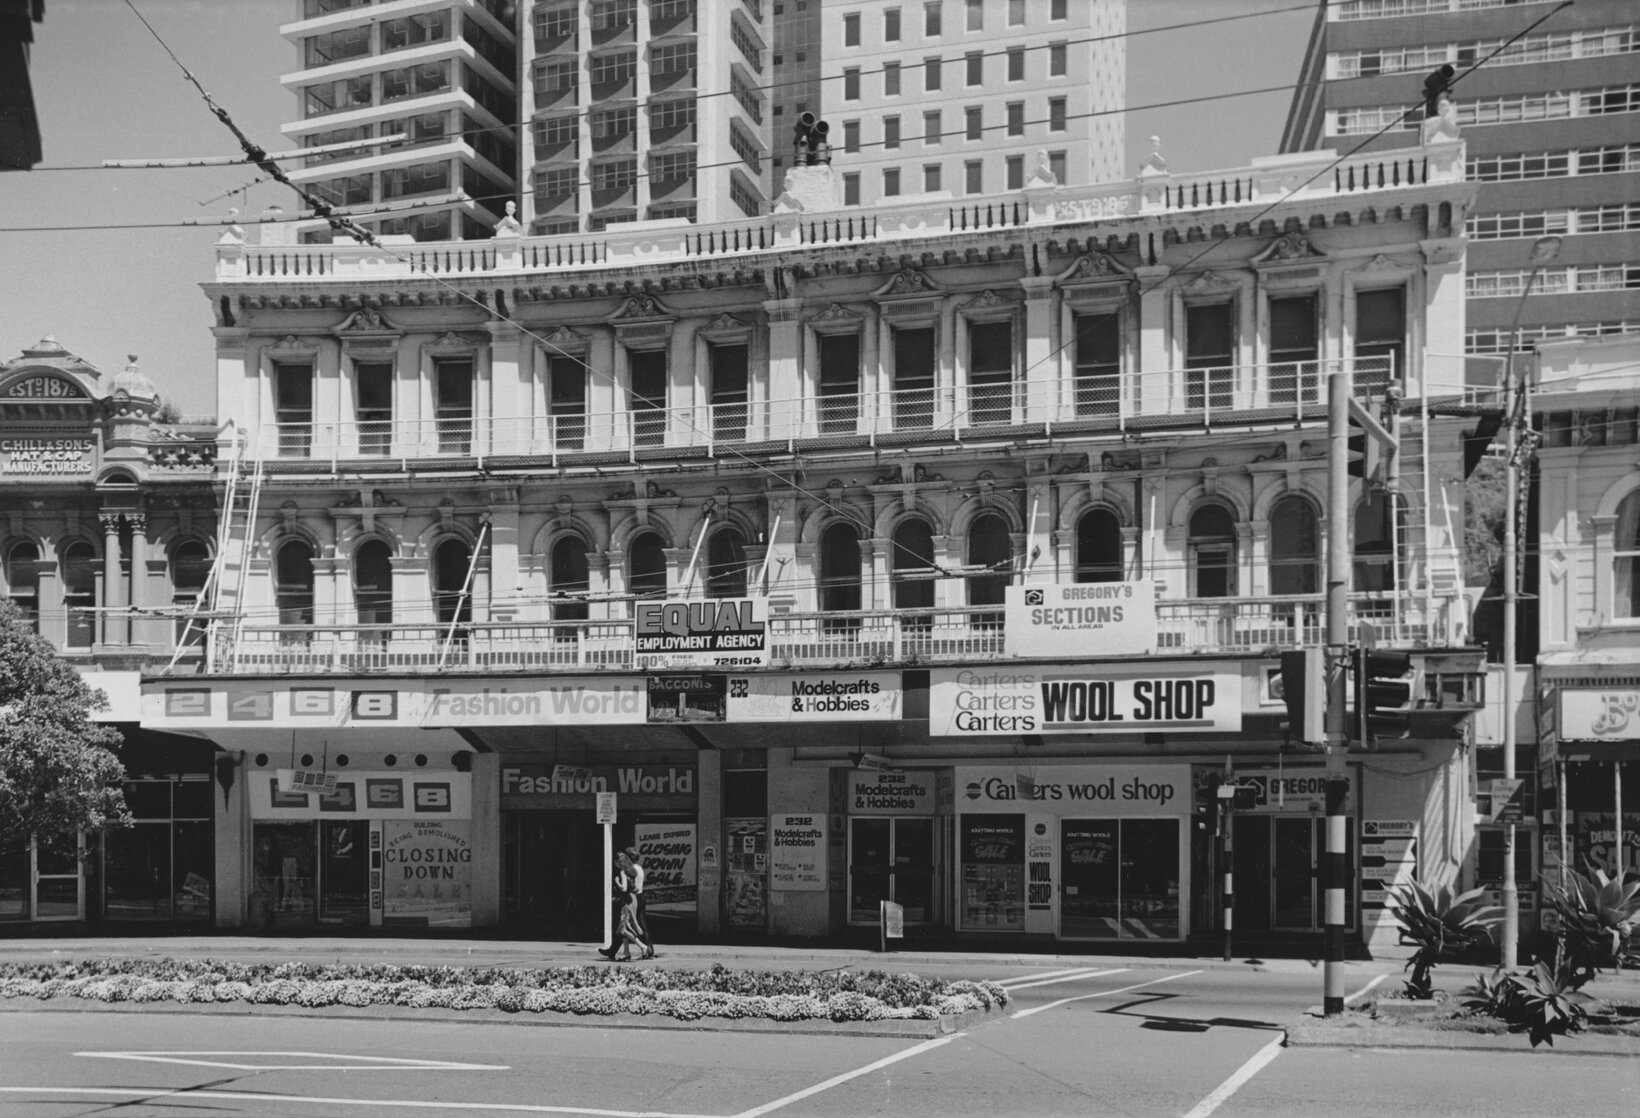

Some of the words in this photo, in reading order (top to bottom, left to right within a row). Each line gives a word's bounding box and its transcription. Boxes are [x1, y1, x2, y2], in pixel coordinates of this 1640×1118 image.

[44, 378, 77, 397] 1875
[11, 451, 41, 461] HAT
[43, 451, 52, 461] &
[55, 451, 83, 461] CAP
[2, 461, 92, 473] MANUFACTURERS
[1062, 585, 1133, 601] GREGORY'S
[637, 601, 765, 637] EQUAL
[1031, 605, 1124, 625] SECTIONS
[637, 636, 713, 650] EMPLOYMENT
[716, 634, 764, 649] AGENCY
[636, 655, 669, 668] 100%
[714, 656, 762, 666] 726104
[730, 679, 749, 698] 232
[791, 680, 880, 697] Modelcrafts
[955, 670, 1036, 691] Carters
[433, 688, 541, 716] Fashion
[550, 685, 639, 715] World
[791, 698, 804, 713] &
[806, 697, 870, 713] Hobbies
[955, 690, 1036, 711] Carters
[1041, 681, 1124, 722] WOOL
[1133, 679, 1216, 721] SHOP
[955, 710, 1036, 731] Carters
[617, 767, 693, 793] World
[878, 774, 906, 783] 232
[855, 783, 926, 796] Modelcrafts
[985, 777, 1063, 801] Carers
[1068, 776, 1116, 800] wool
[1122, 776, 1174, 806] shop
[855, 796, 865, 808] &
[867, 796, 916, 809] Hobbies
[414, 821, 442, 829] BUILDING
[785, 817, 813, 826] 232
[418, 829, 466, 847] DEMOLISHED
[639, 833, 661, 842] LEASE
[663, 830, 691, 839] EXPIRED
[774, 829, 823, 838] Modelcrafts
[639, 843, 692, 855] CLOSING
[774, 837, 781, 847] &
[781, 837, 816, 847] Hobbies
[385, 848, 472, 863] CLOSING
[642, 857, 687, 870] DOWN
[403, 865, 454, 880] DOWN
[645, 871, 684, 886] SALE
[1029, 861, 1052, 882] WOOL
[1029, 883, 1052, 904] SHOP
